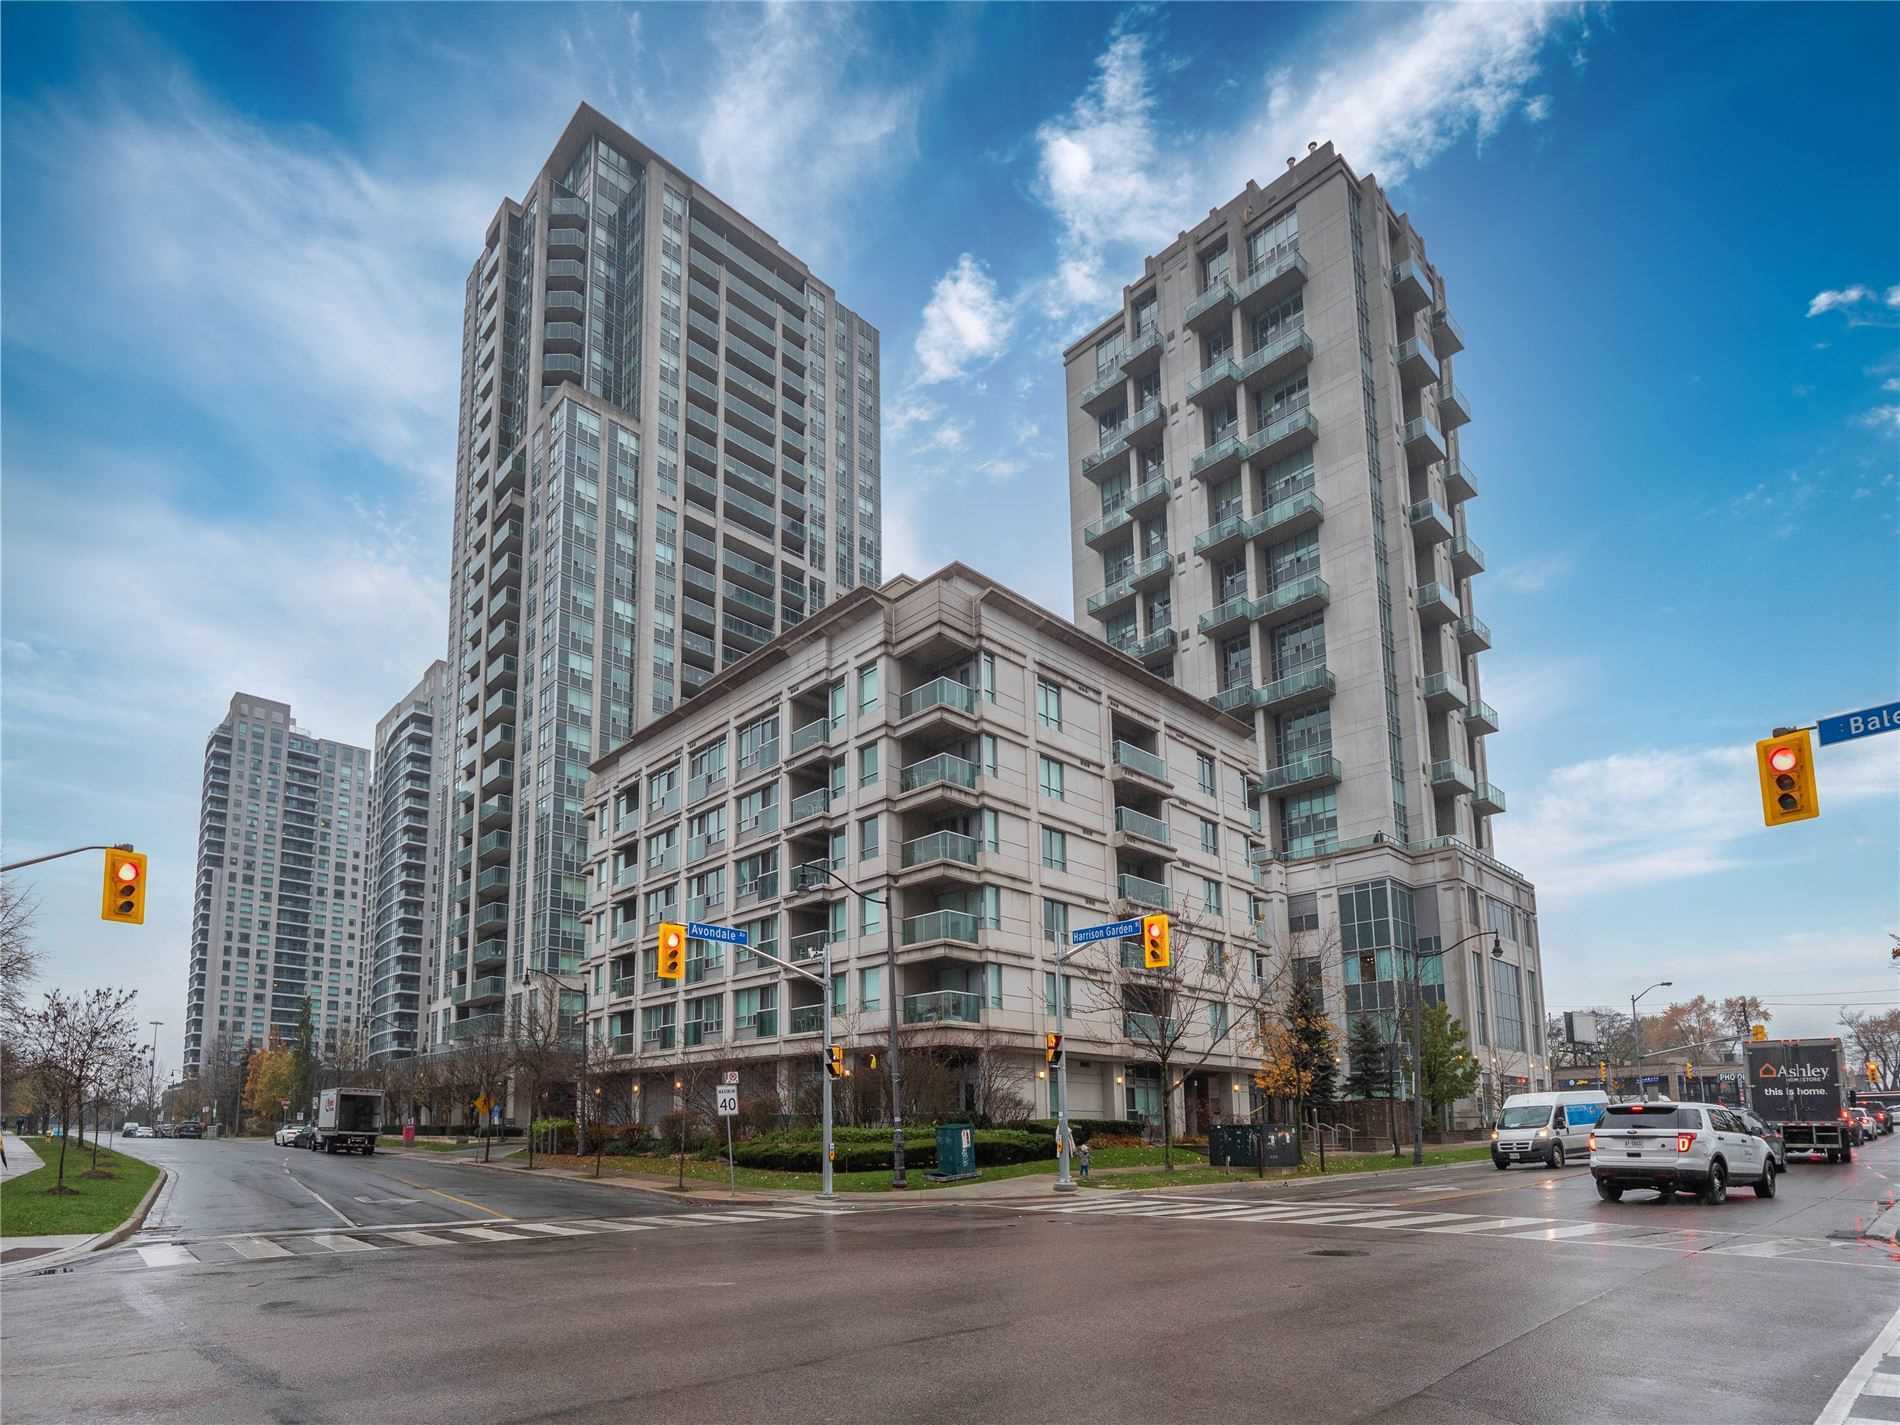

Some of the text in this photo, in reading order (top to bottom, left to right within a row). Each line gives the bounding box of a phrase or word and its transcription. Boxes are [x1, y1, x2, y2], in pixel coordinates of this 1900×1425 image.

[691, 924, 736, 940] Avondale
[1073, 924, 1133, 942] Harrison Garden
[1777, 1063, 1829, 1080] Ashley
[1765, 1087, 1828, 1096] this is home.
[719, 1097, 736, 1111] 40
